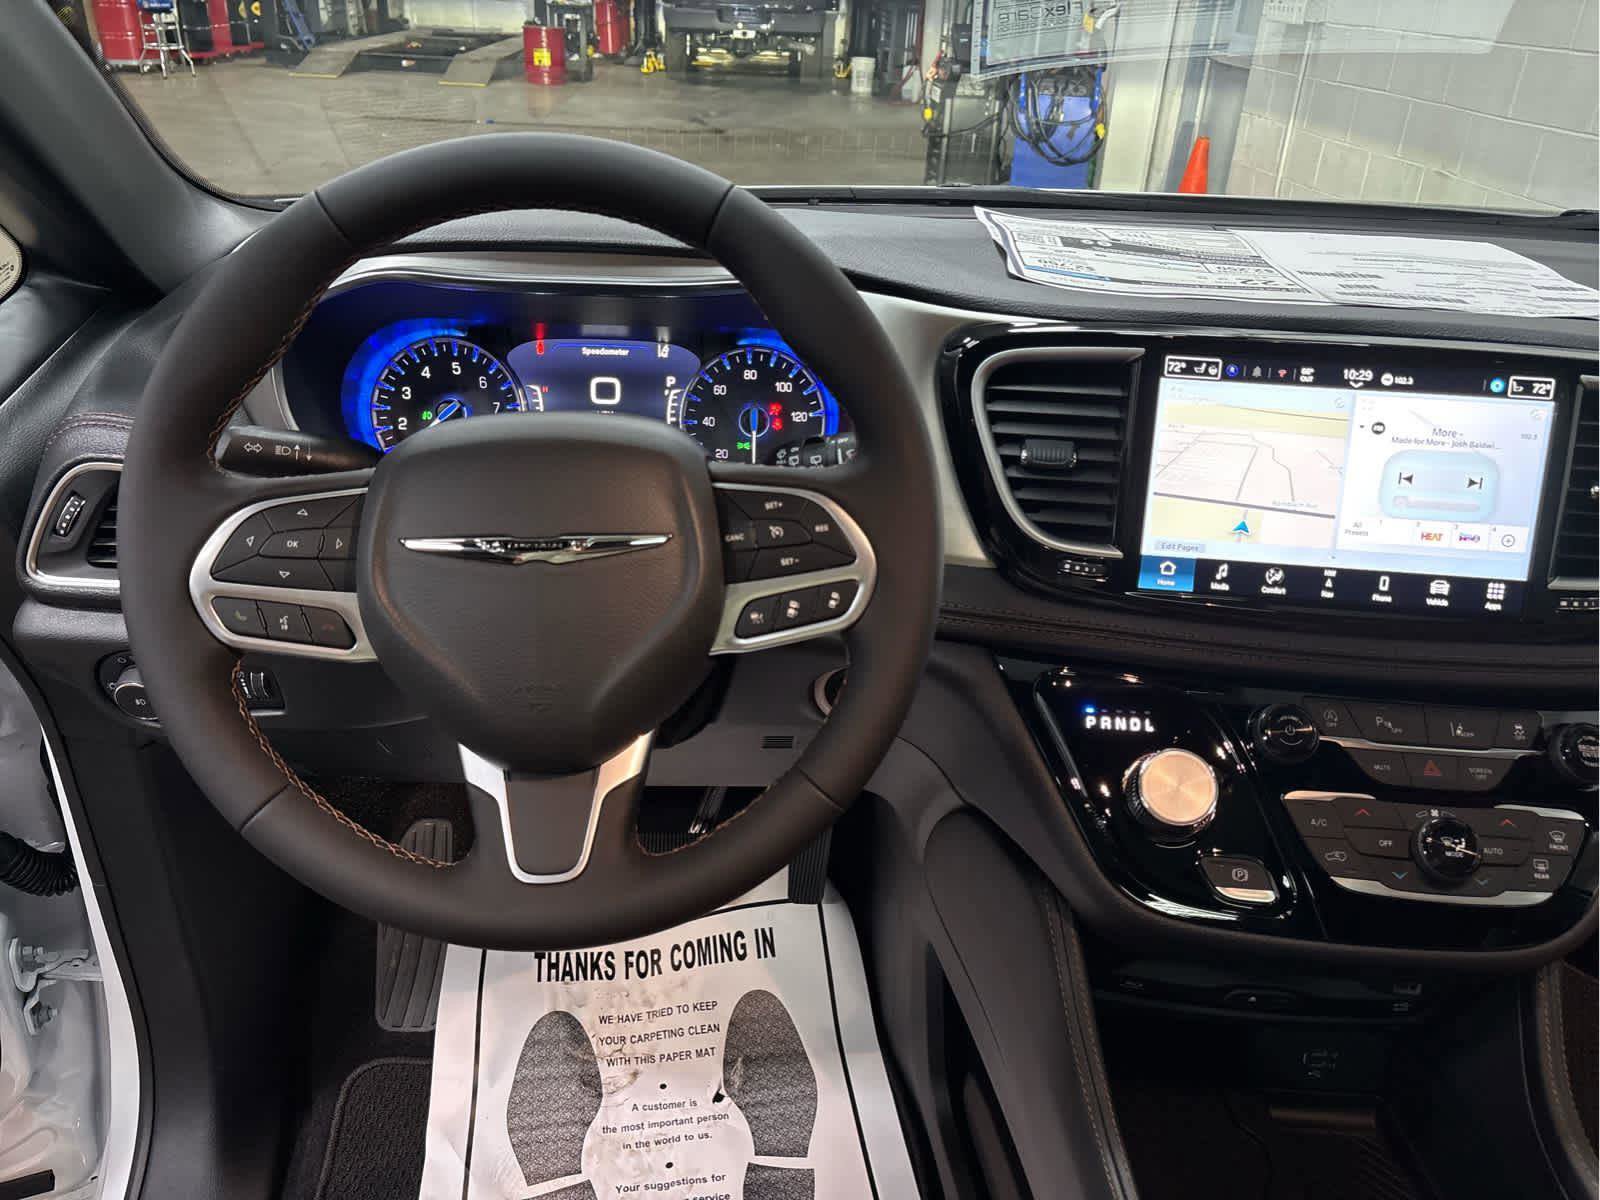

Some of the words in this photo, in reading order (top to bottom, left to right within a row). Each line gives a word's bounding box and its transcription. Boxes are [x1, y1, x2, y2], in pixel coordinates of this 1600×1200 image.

[581, 347, 630, 356] Speedometer
[421, 366, 431, 379] 4
[452, 362, 462, 375] 5
[1168, 361, 1187, 373] 72°
[743, 370, 758, 381] 80
[1343, 369, 1373, 382] 10:29
[478, 376, 488, 389] 6
[666, 376, 676, 387] P
[401, 387, 412, 399] 3
[713, 385, 727, 396] 60
[775, 383, 793, 393] 100
[1532, 383, 1552, 395] 72°
[492, 402, 501, 414] 7
[702, 417, 716, 427] 40
[791, 412, 808, 423] 120
[397, 418, 408, 430] 2
[1432, 427, 1457, 438] More
[1392, 437, 1412, 445] Made
[1414, 437, 1424, 445] for
[1426, 438, 1445, 446] More
[1451, 439, 1468, 448] Josh
[715, 449, 728, 459] 20
[725, 532, 744, 542] CANC
[1421, 532, 1443, 541] HEAT
[287, 540, 299, 548] OK
[1177, 544, 1199, 552] Pages
[1211, 582, 1230, 591] Media
[1261, 585, 1286, 595] Comfort
[1372, 594, 1392, 603] Phone
[1426, 598, 1449, 607] Vehicle
[1484, 602, 1502, 611] Apps
[1310, 819, 1328, 827] A/C
[1483, 848, 1504, 856] AUTO
[534, 951, 616, 982] THANKS
[624, 949, 662, 980] FOR
[670, 930, 747, 971] COMING
[754, 927, 776, 959] IN
[599, 1015, 614, 1025] WE
[617, 1013, 643, 1024] HAVE
[646, 1007, 673, 1020] TRIED
[677, 1004, 690, 1014] TO
[693, 1000, 718, 1012] KEEP
[599, 1036, 627, 1046] YOUR
[630, 1027, 685, 1044] CARPETING
[688, 1023, 720, 1037] CLEAN
[606, 1056, 631, 1067] WITH
[634, 1055, 656, 1065] THIS
[659, 1050, 692, 1063] PAPER
[695, 1047, 716, 1058] MAT
[632, 1103, 639, 1112] A
[642, 1100, 686, 1112] customer
[690, 1098, 698, 1107] is
[602, 1124, 617, 1134] the
[621, 1122, 645, 1133] most
[648, 1116, 694, 1130] important
[697, 1112, 729, 1125] person
[623, 1141, 632, 1150] in
[635, 1138, 650, 1149] the
[654, 1135, 681, 1147] world
[684, 1132, 694, 1141] to
[698, 1132, 713, 1140] us.
[616, 1183, 641, 1194] Your
[644, 1175, 707, 1192] suggestions
[711, 1173, 727, 1183] for
